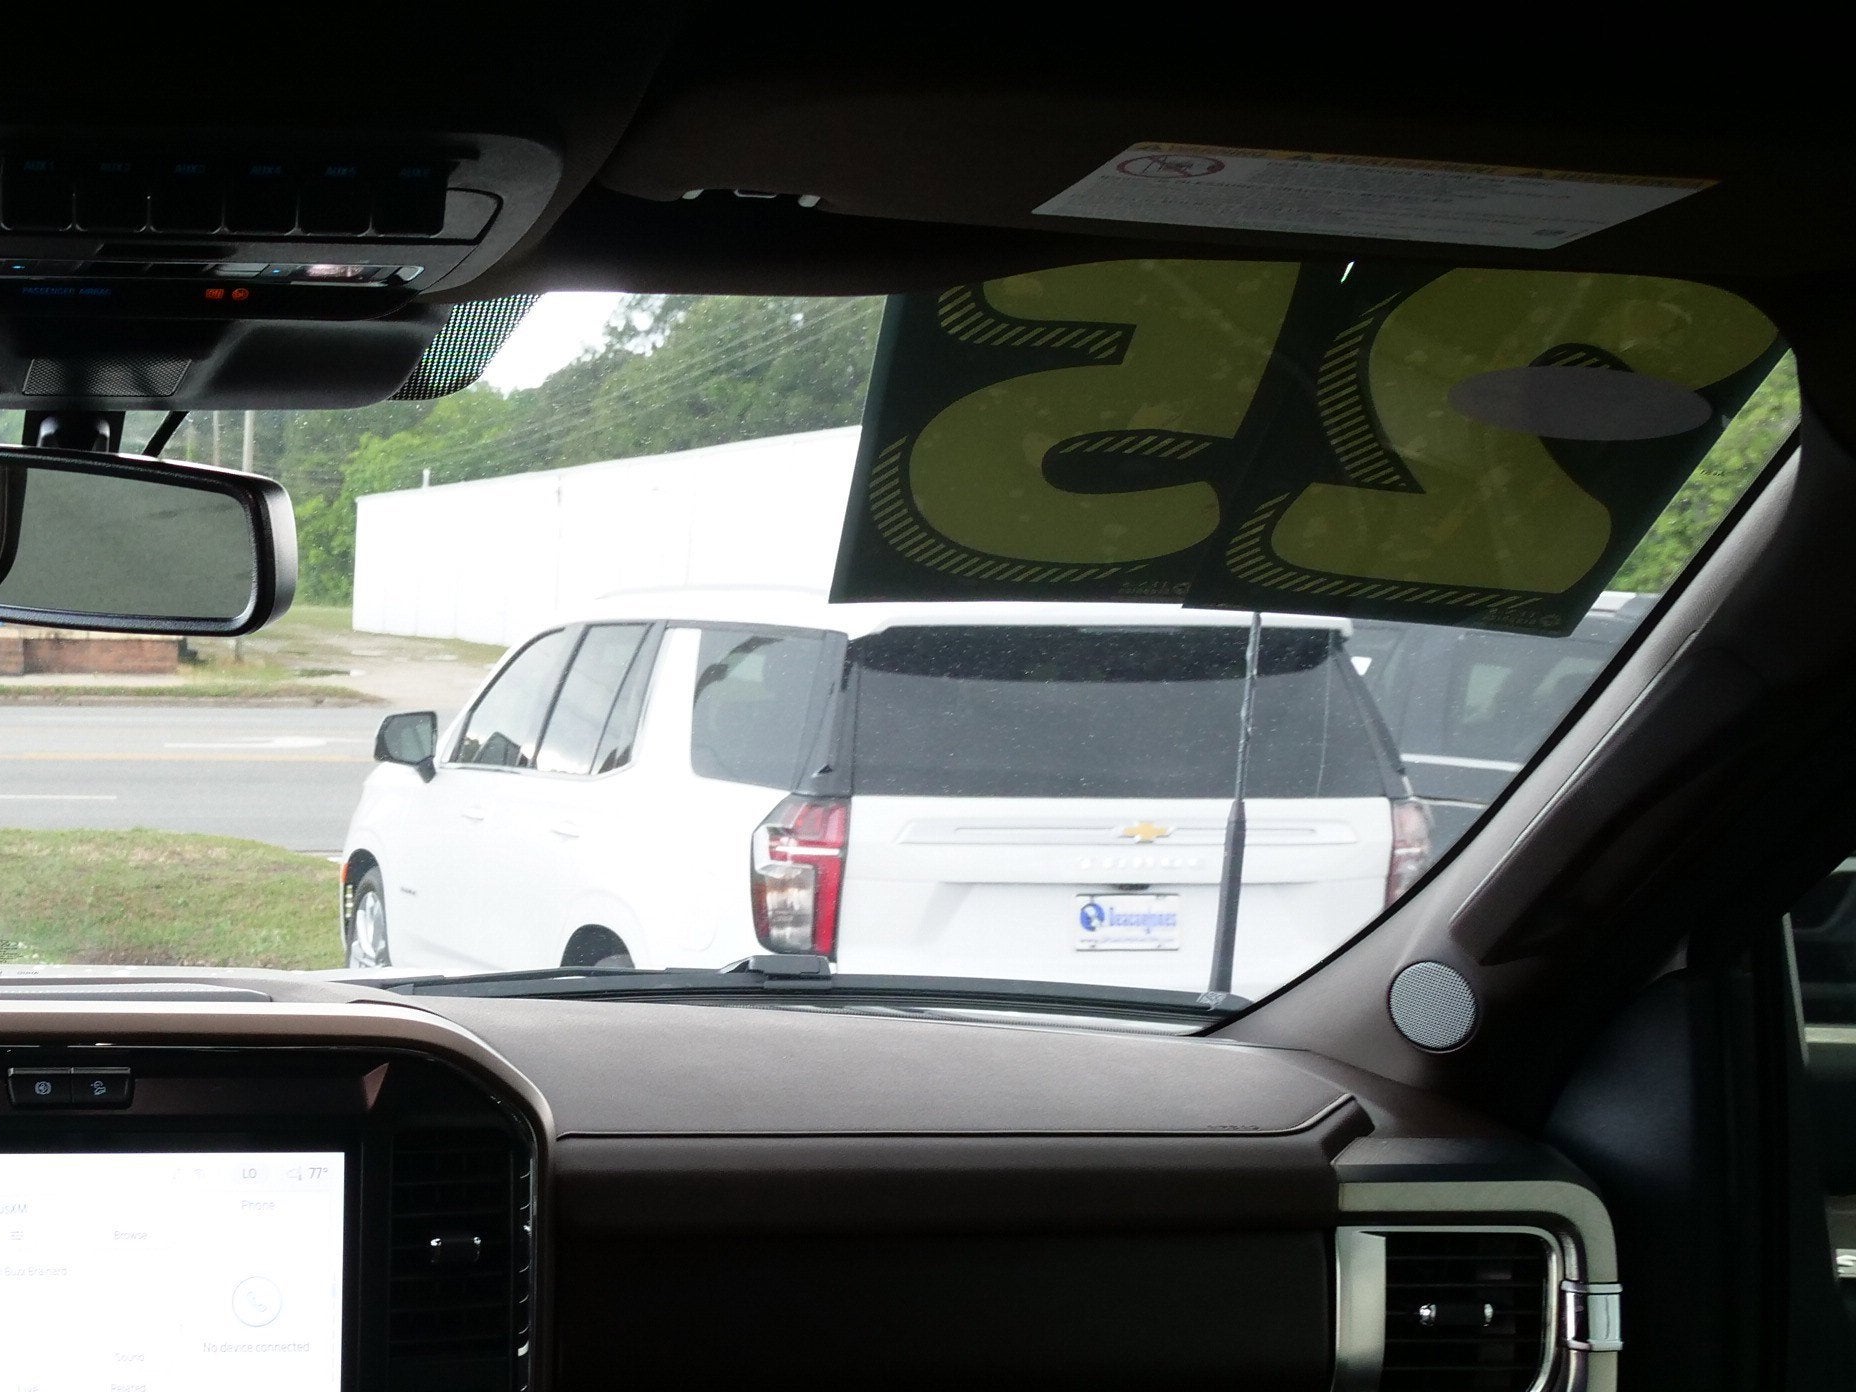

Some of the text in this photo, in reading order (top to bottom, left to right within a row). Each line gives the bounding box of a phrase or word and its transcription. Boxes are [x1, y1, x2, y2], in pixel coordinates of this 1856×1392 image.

[203, 1342, 310, 1352] No device connected
